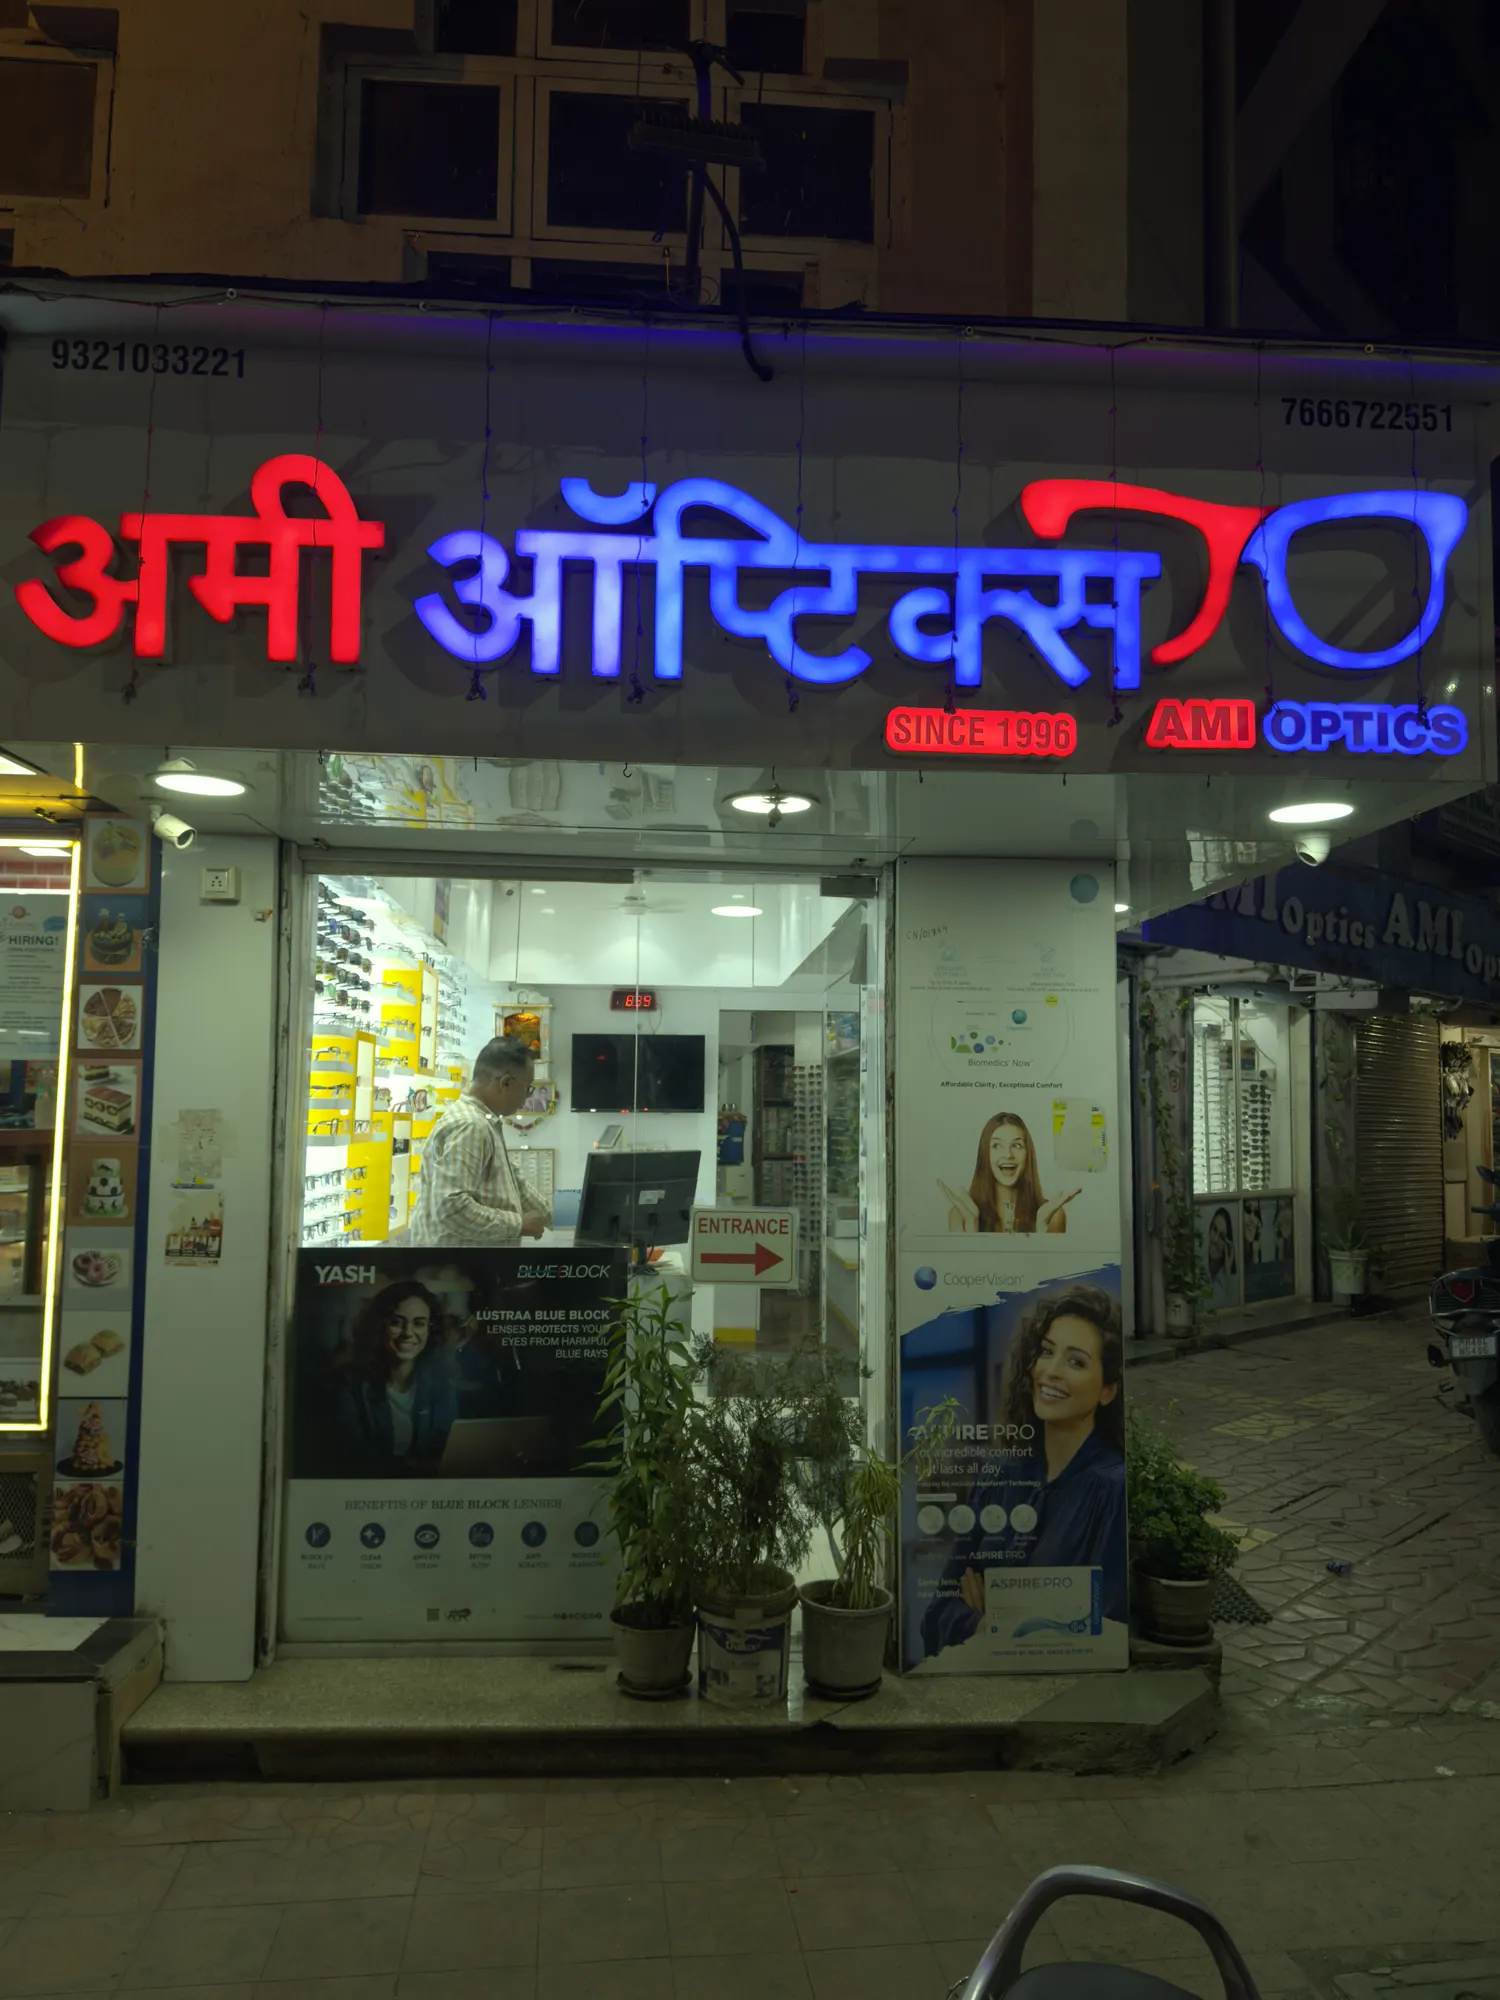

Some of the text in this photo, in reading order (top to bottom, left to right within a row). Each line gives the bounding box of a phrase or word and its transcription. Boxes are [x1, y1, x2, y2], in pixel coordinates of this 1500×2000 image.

[51, 338, 246, 379] 9321033221
[1281, 397, 1453, 433] 7666722551
[14, 453, 1162, 690] अमी ऑप्टिक्स
[892, 714, 1071, 751] SINCE 1996
[1153, 704, 1463, 748] AMI OPTICS
[9, 935, 59, 946] HIRING!
[1281, 897, 1376, 949] Optics
[1383, 892, 1464, 960] AMI
[1465, 943, 1500, 986] Op
[940, 1080, 973, 1088] Affordable
[999, 1081, 1035, 1089] Exceptional
[1036, 1081, 1063, 1089] Comfort
[698, 1217, 789, 1235] ENTRANCE
[315, 1265, 376, 1284] YASH
[476, 1310, 610, 1320] LUSTRAA BLUE BLOCK
[486, 1324, 527, 1334] LENSES
[528, 1324, 580, 1334] PROTECTS
[501, 1336, 608, 1346] EYES FROM HARMFUL
[555, 1349, 609, 1358] BLUE RAYS
[993, 1423, 1035, 1441] PRO
[989, 1445, 1034, 1458] comfort
[940, 1462, 964, 1474] lasts
[967, 1462, 978, 1474] all
[981, 1462, 1004, 1476] day.
[344, 1498, 562, 1511] BENEFITS OF BLUE BLOCK LENSES
[968, 1551, 1003, 1560] ASPIRE
[1004, 1550, 1026, 1560] PRO
[990, 1577, 1073, 1590] ASPIRE PRO
